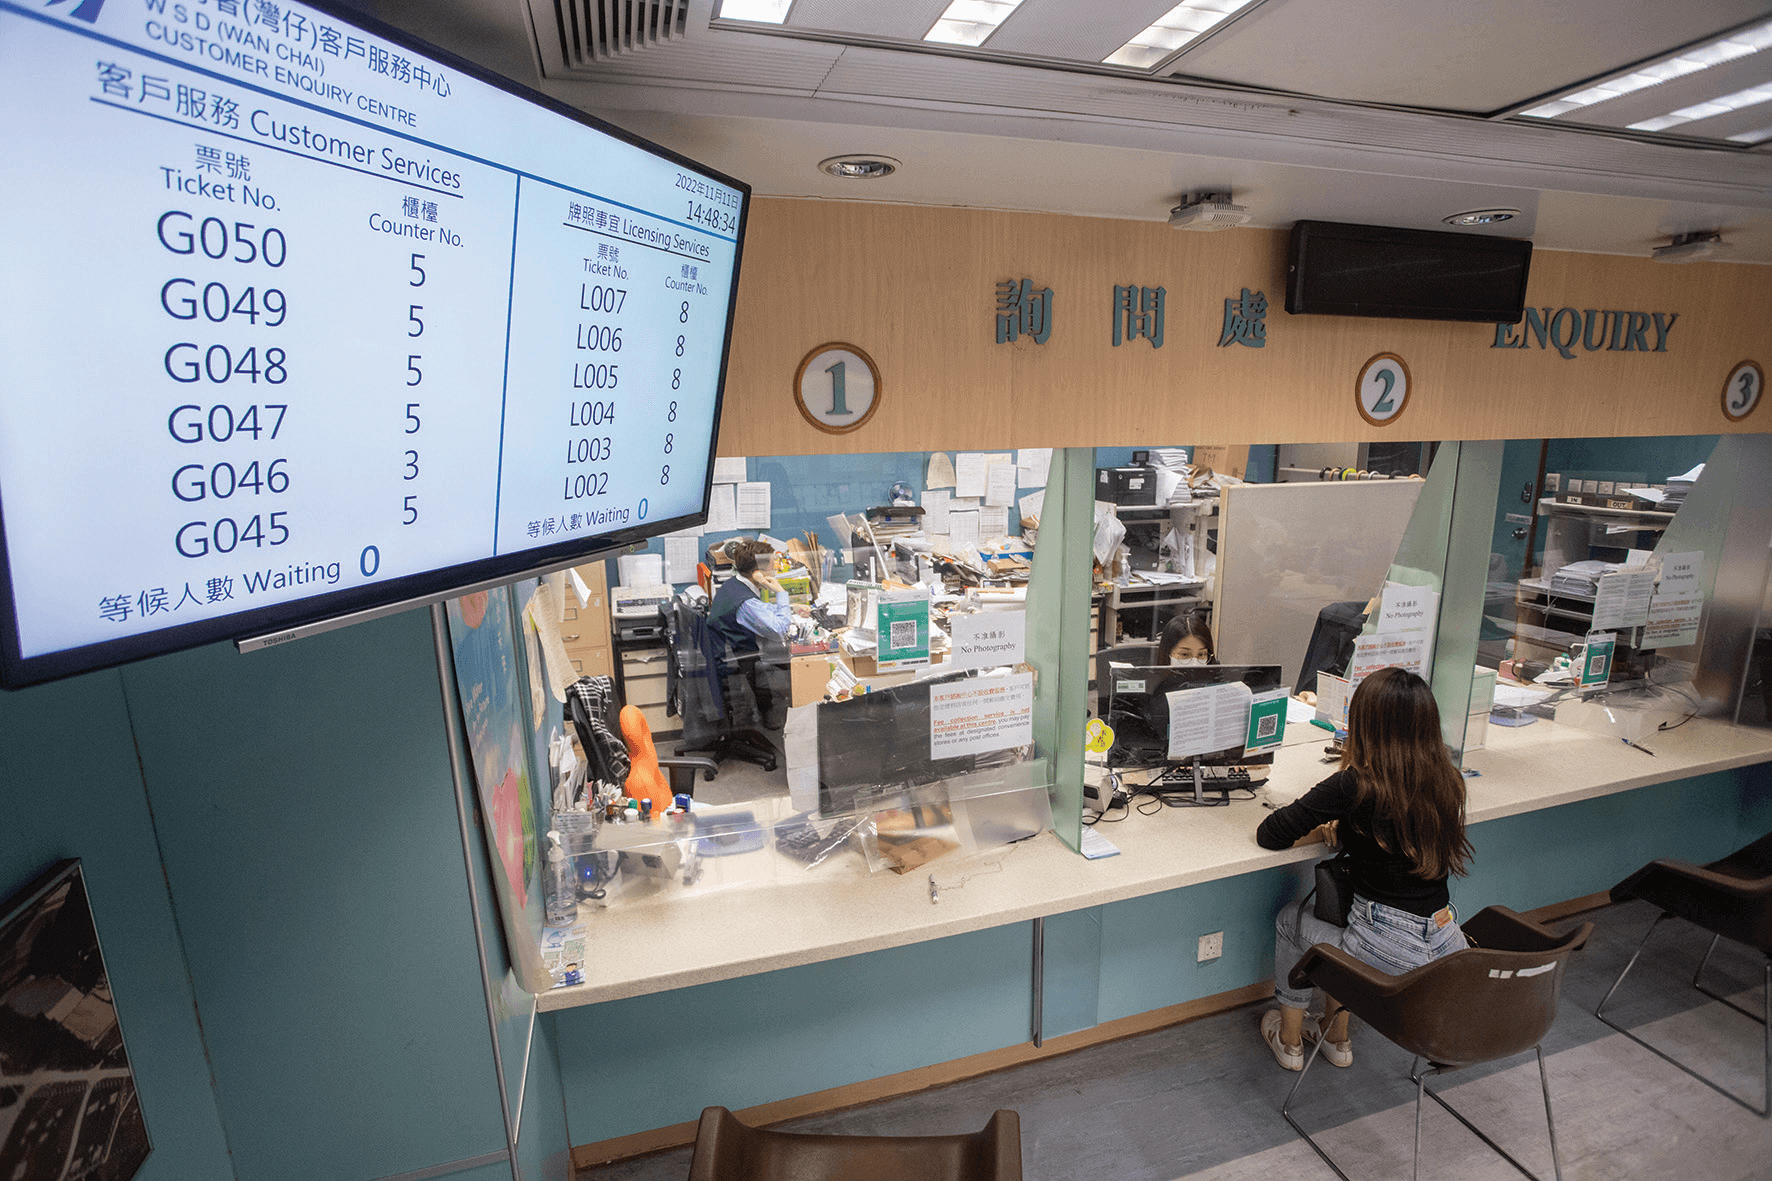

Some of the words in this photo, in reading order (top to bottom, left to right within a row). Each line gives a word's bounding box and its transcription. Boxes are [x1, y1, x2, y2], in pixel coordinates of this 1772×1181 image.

[217, 20, 270, 54] (WAN
[275, 40, 326, 77] CHAI)
[145, 20, 270, 78] CUSTOMER
[274, 65, 353, 105] ENQUIRY
[357, 94, 417, 128] CENTRE
[96, 60, 240, 131] 客戶服務
[250, 109, 375, 165] Customer
[381, 148, 463, 190] Services
[194, 144, 251, 183] 票號
[159, 166, 235, 203] Ticket
[243, 186, 282, 213] No.
[675, 173, 740, 210] 2022年11月11日
[368, 213, 436, 242] Counter
[439, 226, 465, 249] No.
[568, 201, 621, 234] 牌照事宜
[623, 218, 672, 250] Licensing
[673, 234, 711, 258] Services
[687, 200, 736, 235] 14:48:34
[157, 210, 287, 269] G050
[409, 254, 427, 289] 5
[583, 258, 612, 278] Ticket
[613, 267, 629, 280] No.
[597, 243, 620, 264] 票號
[580, 283, 627, 314] L007
[679, 300, 690, 324] 8
[665, 276, 695, 293] Counter
[696, 282, 709, 296] No.
[160, 277, 287, 328] G049
[408, 304, 425, 338] 5
[577, 323, 623, 353] L006
[675, 335, 686, 357] 8
[1490, 306, 1681, 360] ENQUIRY
[164, 342, 289, 385] G048
[406, 355, 423, 387] 5
[573, 363, 619, 389] L005
[671, 368, 682, 390] 8
[824, 361, 854, 415] 1
[1371, 368, 1397, 413] 2
[1731, 372, 1755, 410] 3
[168, 404, 289, 444] G047
[404, 403, 421, 434] 5
[570, 401, 615, 426] L004
[668, 401, 678, 423] 8
[567, 436, 612, 464] L003
[664, 433, 674, 454] 8
[172, 458, 291, 502] G046
[403, 449, 420, 481] 3
[564, 472, 609, 500] L002
[660, 464, 670, 485] 8
[527, 513, 583, 539] 等候人數
[586, 506, 630, 527] Waiting
[637, 498, 649, 520] 0
[1612, 501, 1627, 509] OUT
[175, 511, 290, 558] G045
[402, 496, 418, 526] 5
[98, 574, 235, 624] 等候人數
[243, 559, 342, 596] Waiting
[359, 544, 381, 578] 0
[263, 633, 296, 646] TOSHIBA
[960, 646, 972, 654] No
[974, 641, 1016, 653] Photography
